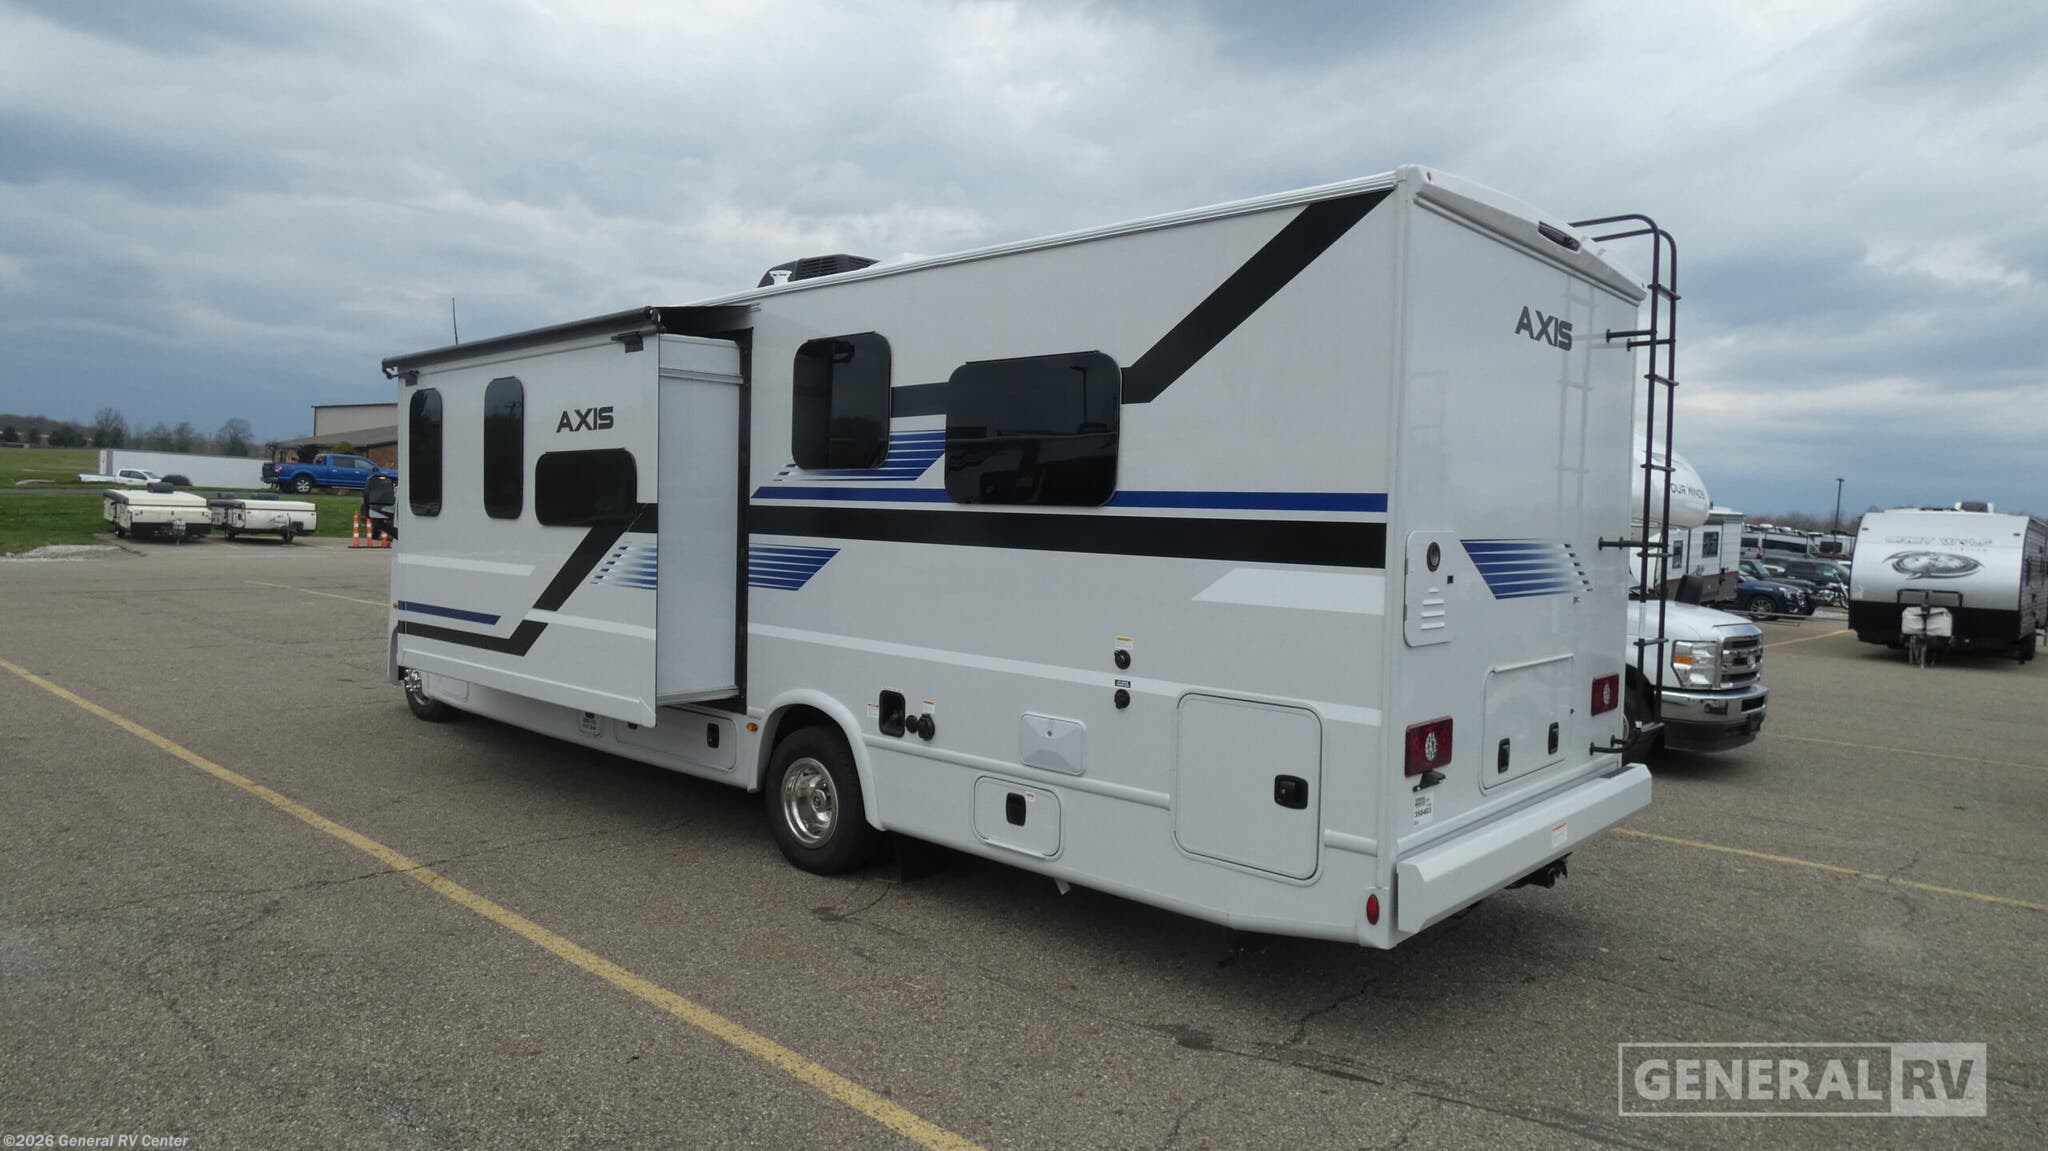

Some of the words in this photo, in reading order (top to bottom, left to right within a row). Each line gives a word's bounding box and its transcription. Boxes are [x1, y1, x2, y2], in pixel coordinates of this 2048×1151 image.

[1514, 305, 1573, 351] AXIS
[556, 406, 614, 433] AXIS
[1670, 483, 1686, 495] OUR
